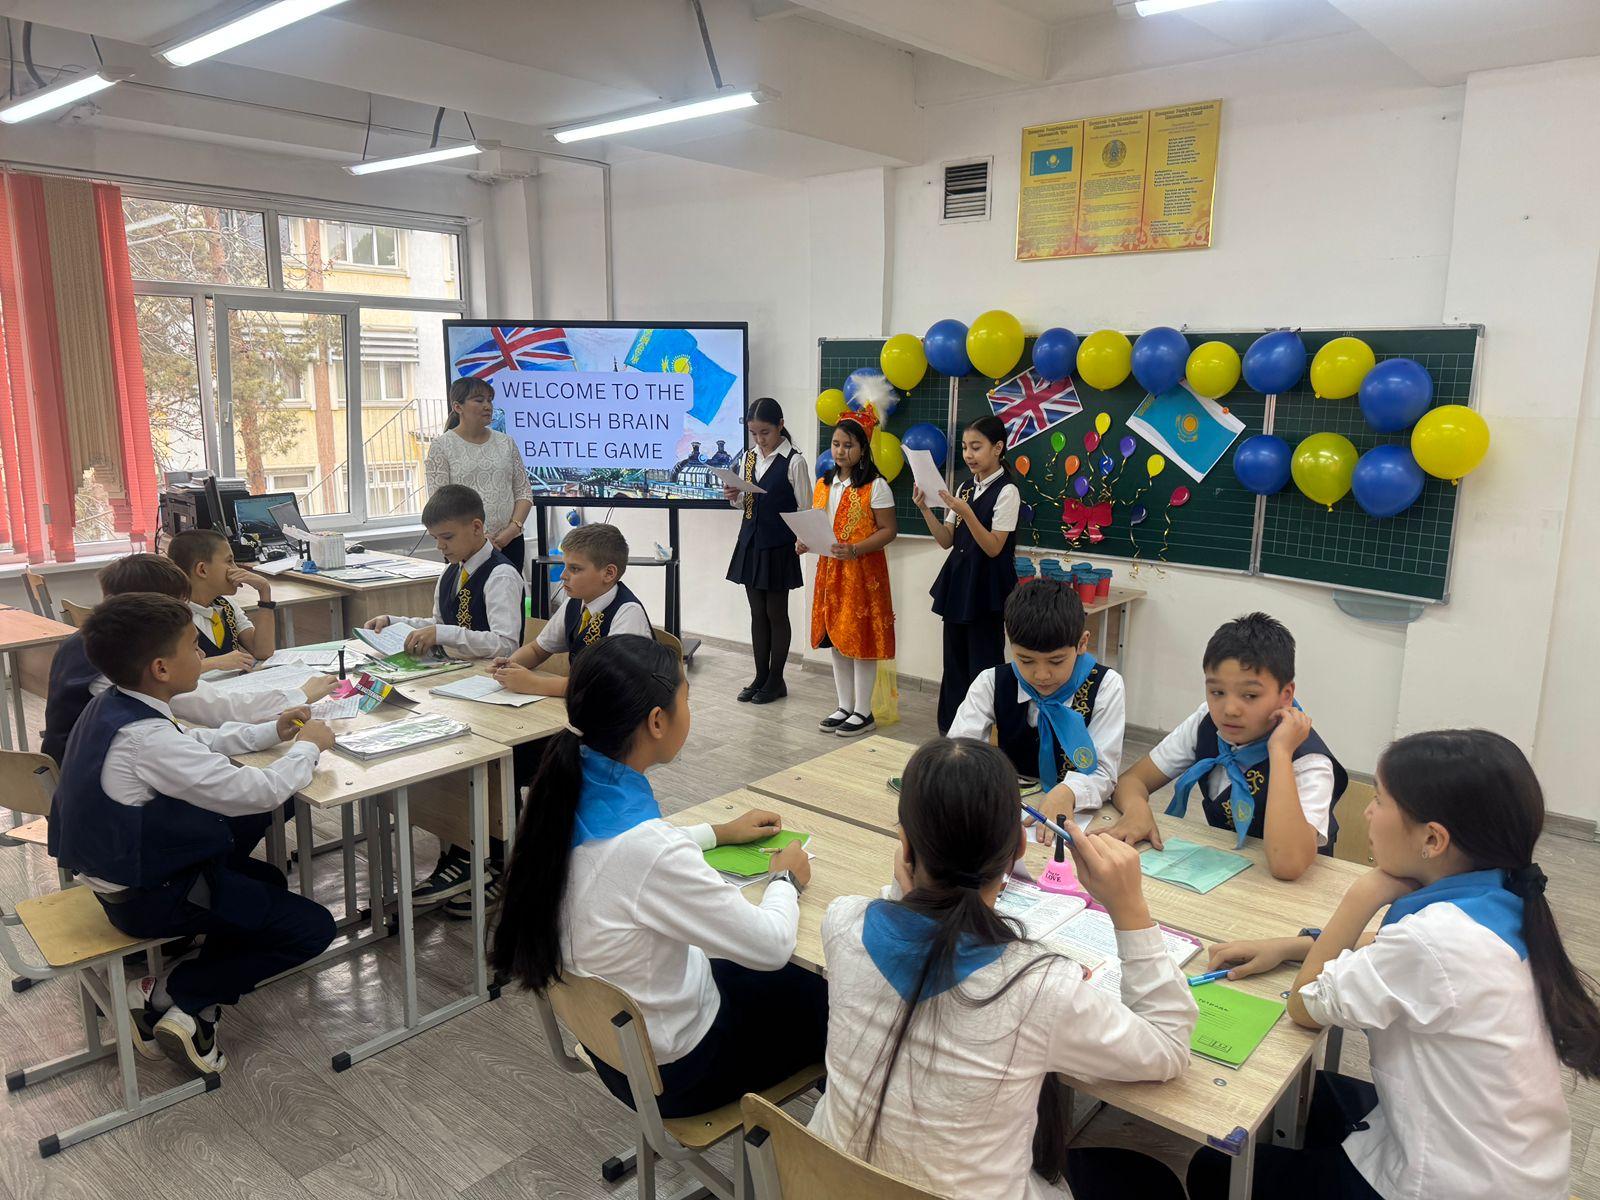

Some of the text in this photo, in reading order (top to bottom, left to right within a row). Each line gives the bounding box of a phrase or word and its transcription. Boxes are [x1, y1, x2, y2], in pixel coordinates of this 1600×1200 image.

[502, 382, 685, 401] WELCOME TO THE
[514, 411, 669, 430] ENGLISH BRAIN
[524, 441, 663, 459] BATTLE GAME
[1045, 872, 1062, 882] LOVE
